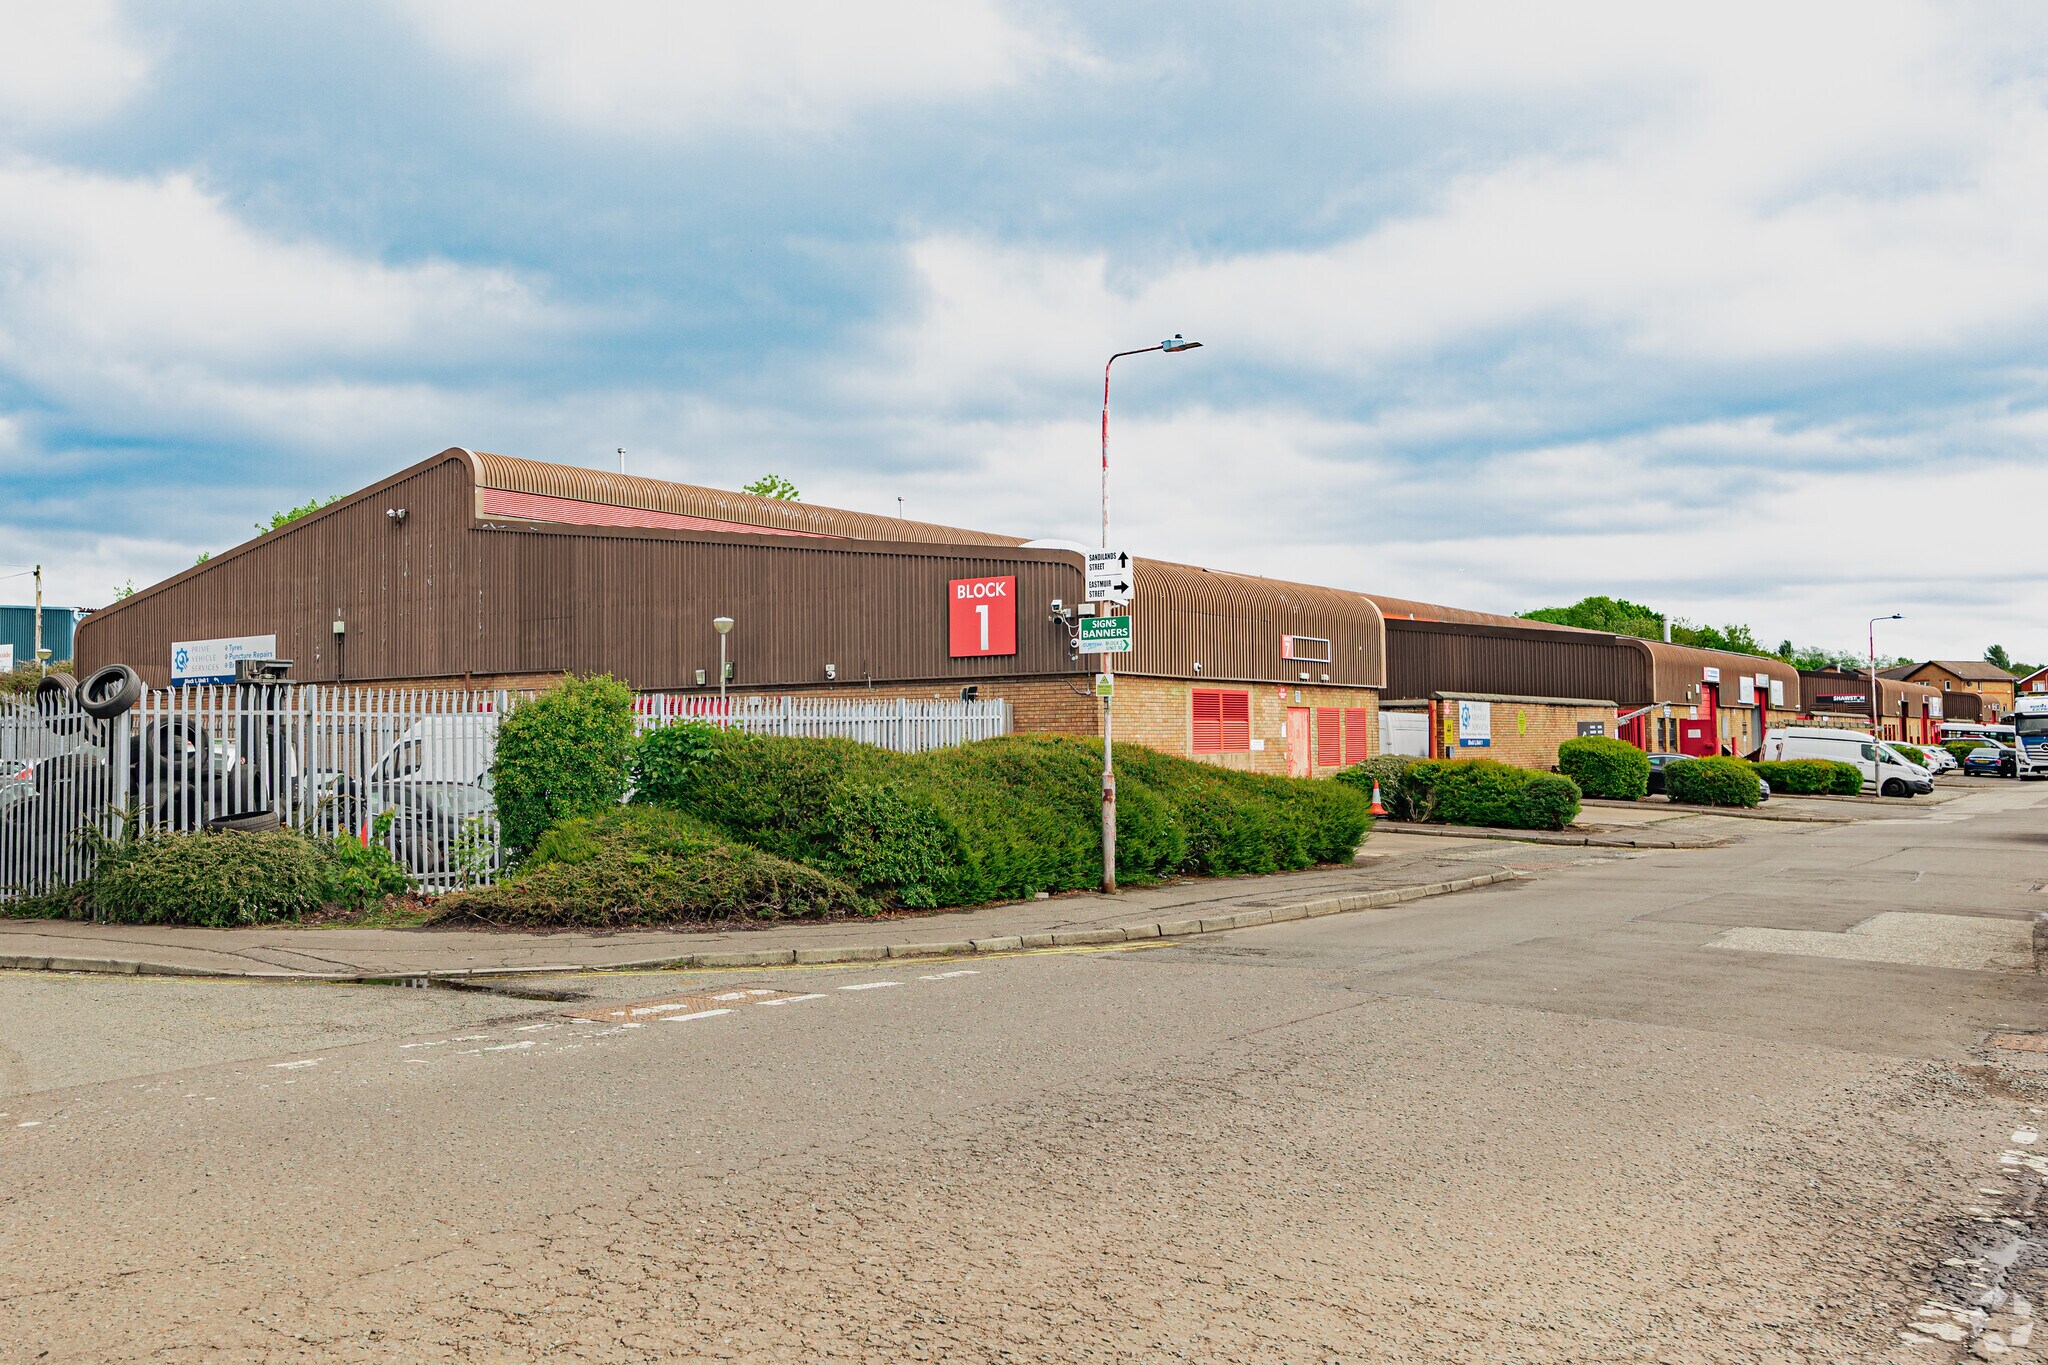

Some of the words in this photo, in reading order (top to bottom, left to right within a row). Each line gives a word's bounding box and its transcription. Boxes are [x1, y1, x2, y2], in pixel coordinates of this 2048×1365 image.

[1089, 552, 1117, 562] SANDILANDS
[1089, 563, 1105, 571] STREET
[1089, 580, 1112, 588] EASTMUIR
[957, 581, 1007, 600] BLOCK
[1089, 590, 1105, 598] STREET
[975, 604, 989, 651] 1
[1092, 619, 1117, 629] SIGNS
[1082, 628, 1128, 639] BANNERS
[191, 645, 209, 653] PRIME
[229, 644, 243, 653] Tyres
[1284, 642, 1290, 657] 7
[191, 654, 216, 662] VEHICLE
[228, 652, 252, 660] Puncture
[253, 651, 273, 659] Repairs
[191, 664, 219, 672] SERVICES
